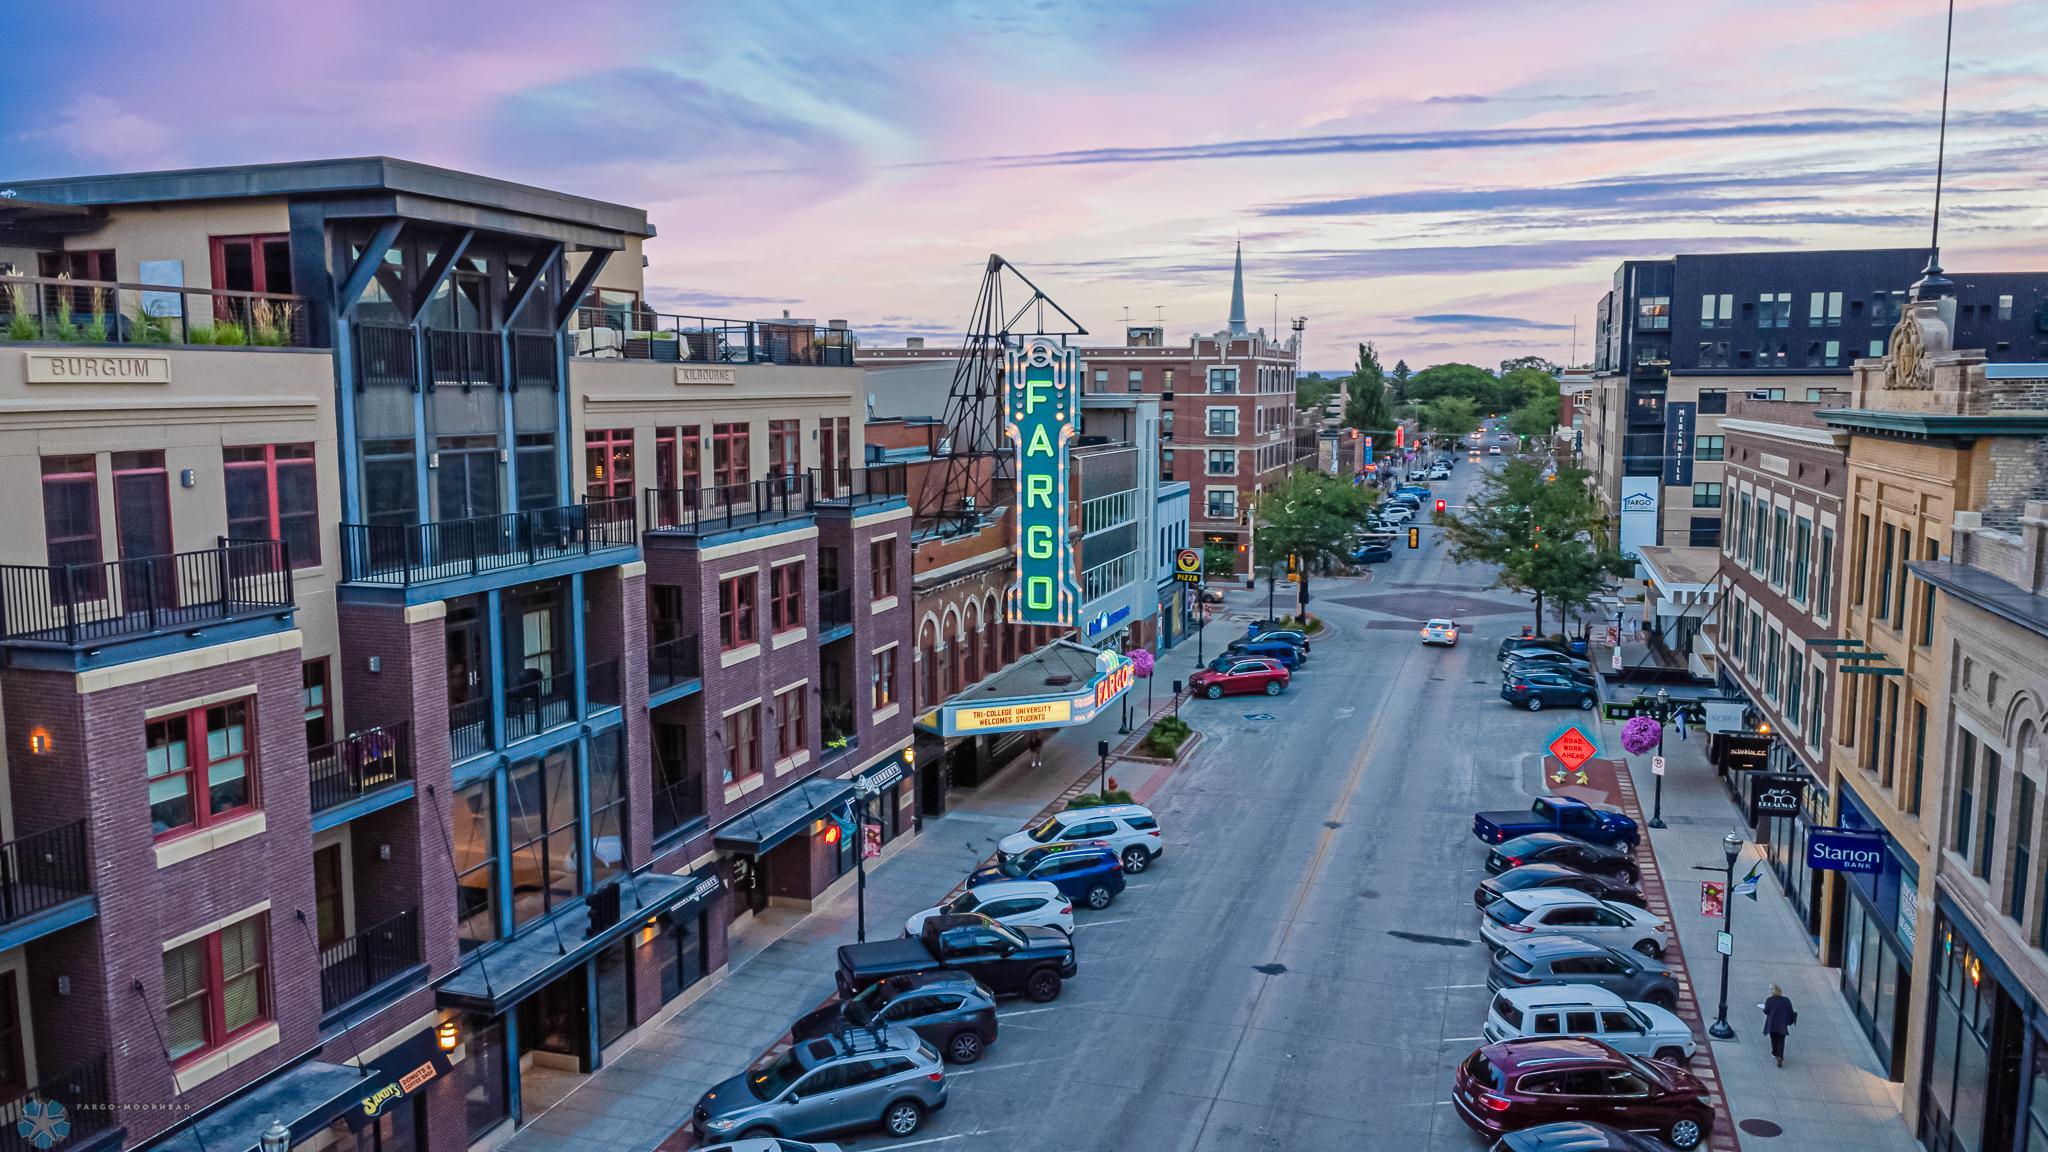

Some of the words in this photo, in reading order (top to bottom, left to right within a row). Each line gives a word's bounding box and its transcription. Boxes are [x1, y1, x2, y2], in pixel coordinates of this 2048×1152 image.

[51, 358, 149, 377] BURGUM
[683, 369, 730, 381] KILBOURNE
[1676, 409, 1685, 481] MERCANTILE
[1026, 380, 1054, 610] FARGO
[1177, 574, 1198, 582] PIZZA
[1097, 664, 1129, 708] FARGO
[973, 708, 1012, 719] TRI-COLLEGE
[1015, 705, 1051, 715] UNIVERSITY
[979, 715, 1012, 726] WELCOMES
[1015, 713, 1046, 723] STUDENTS
[1813, 843, 1880, 863] Starion
[1844, 861, 1871, 869] BANK
[402, 1069, 426, 1086] DONUTS
[404, 1077, 422, 1091] COFFEE
[421, 1070, 434, 1080] SHOP
[361, 1083, 402, 1115] SANDY'S
